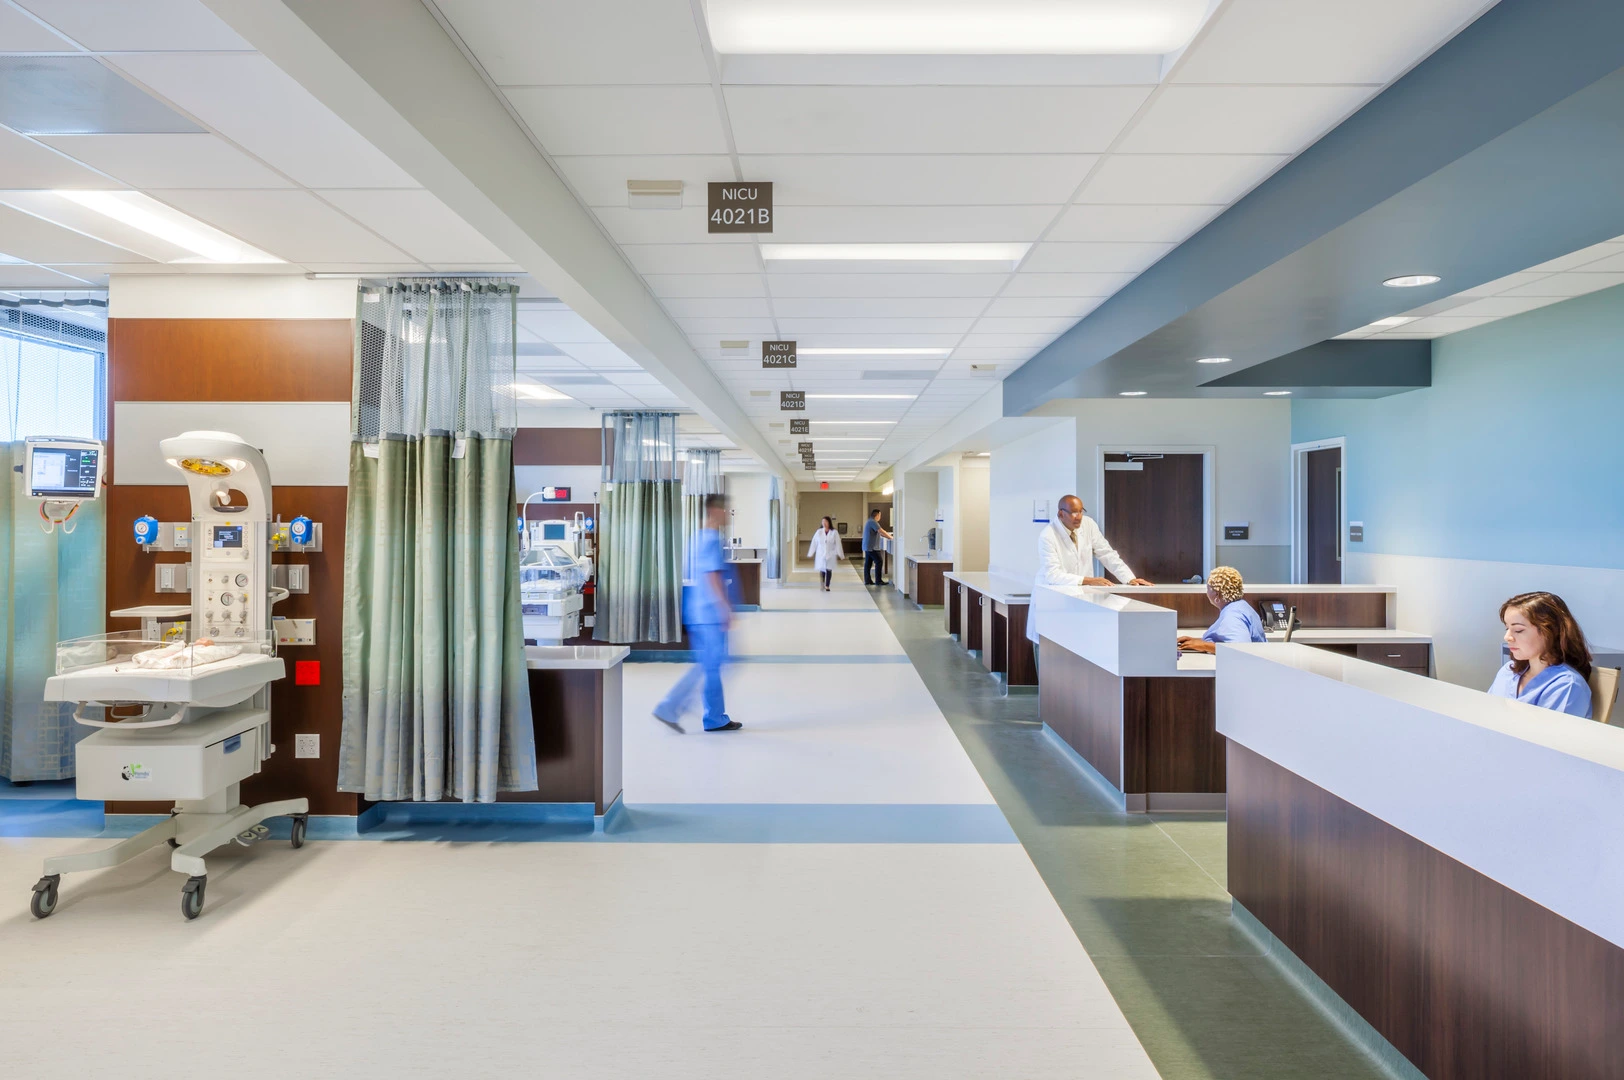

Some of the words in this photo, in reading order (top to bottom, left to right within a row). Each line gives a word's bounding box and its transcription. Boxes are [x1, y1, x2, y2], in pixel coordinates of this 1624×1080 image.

[722, 188, 758, 200] NICU
[710, 208, 770, 224] 4021B
[763, 354, 796, 364] 4021C
[781, 400, 804, 408] 4021D
